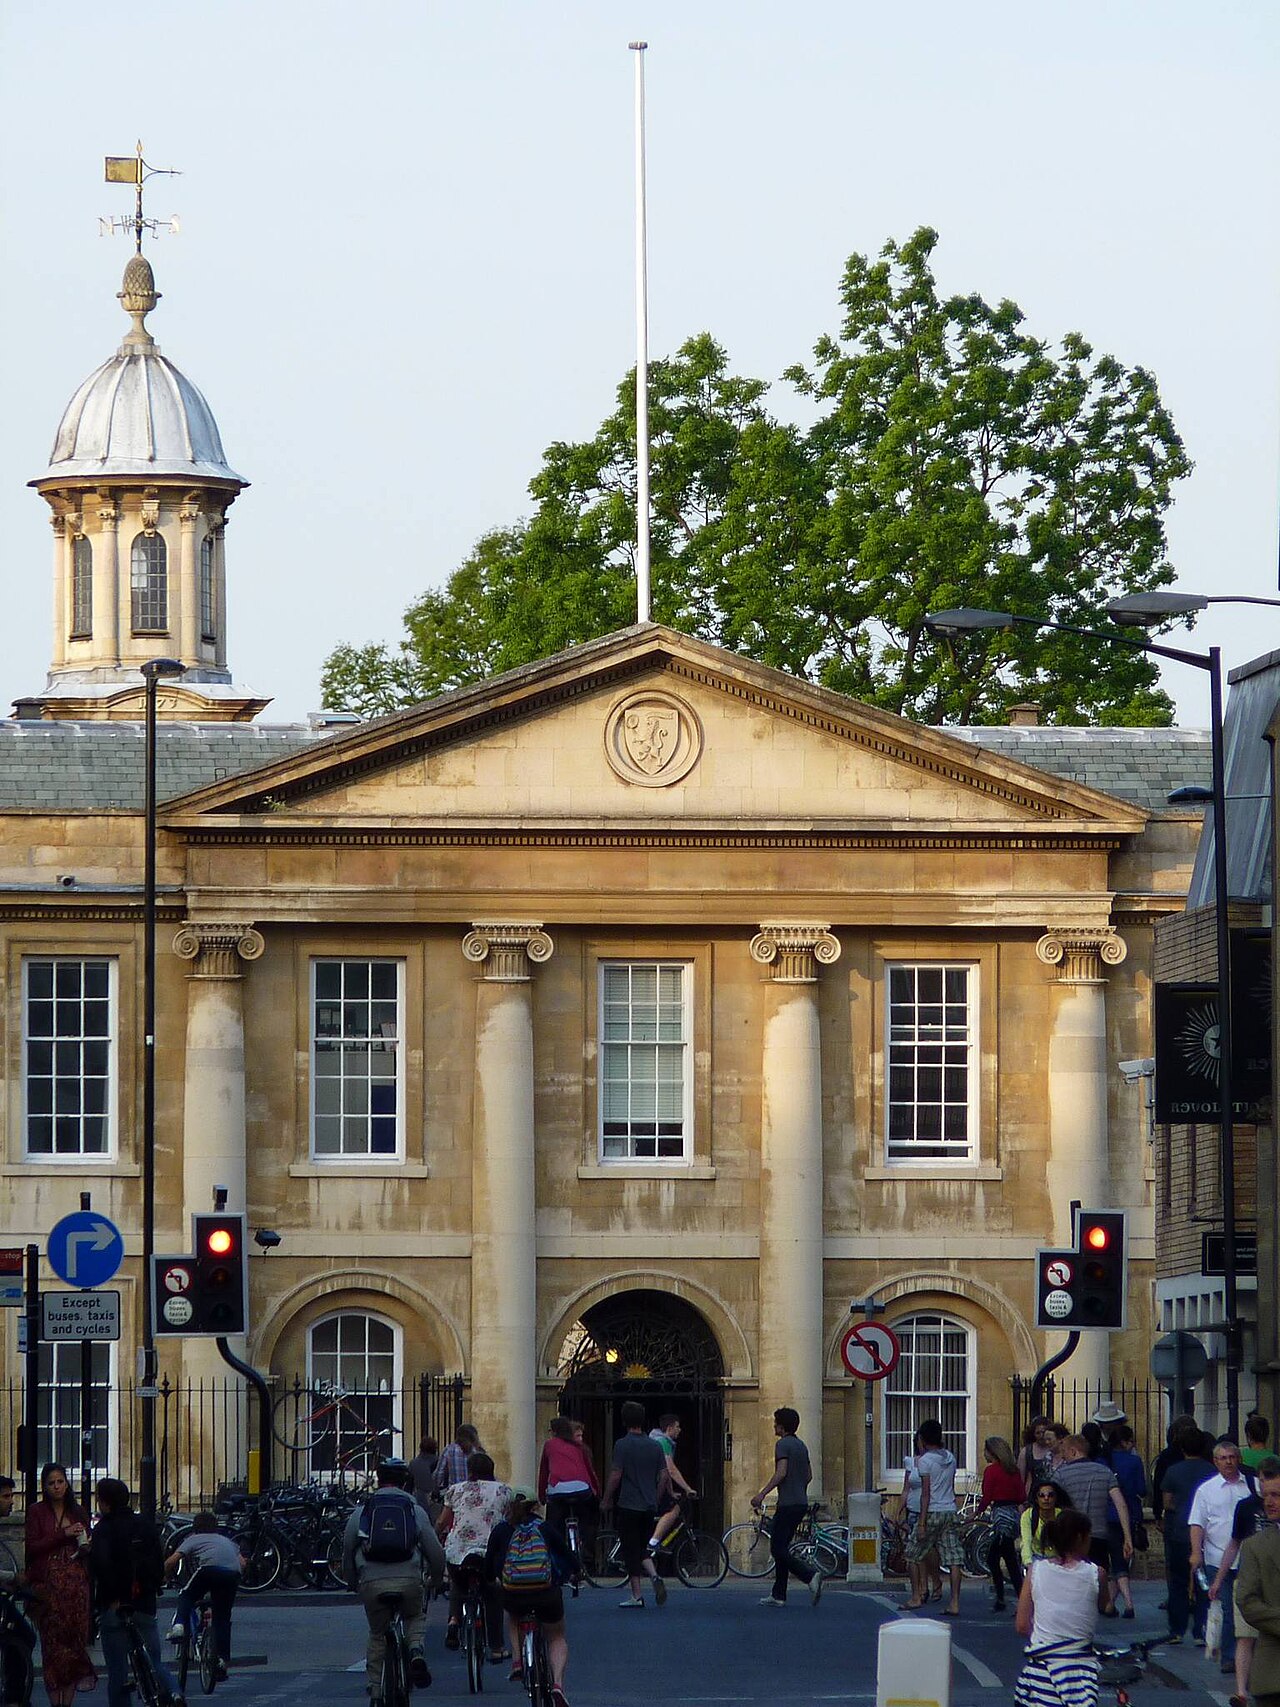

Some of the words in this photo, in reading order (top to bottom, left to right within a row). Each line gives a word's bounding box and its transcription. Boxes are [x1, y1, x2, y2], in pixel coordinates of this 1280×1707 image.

[1171, 1101, 1261, 1114] REVOLTIO
[62, 1297, 101, 1309] Except
[88, 1310, 115, 1321] taxis
[52, 1324, 72, 1334] and
[75, 1324, 111, 1336] cycles
